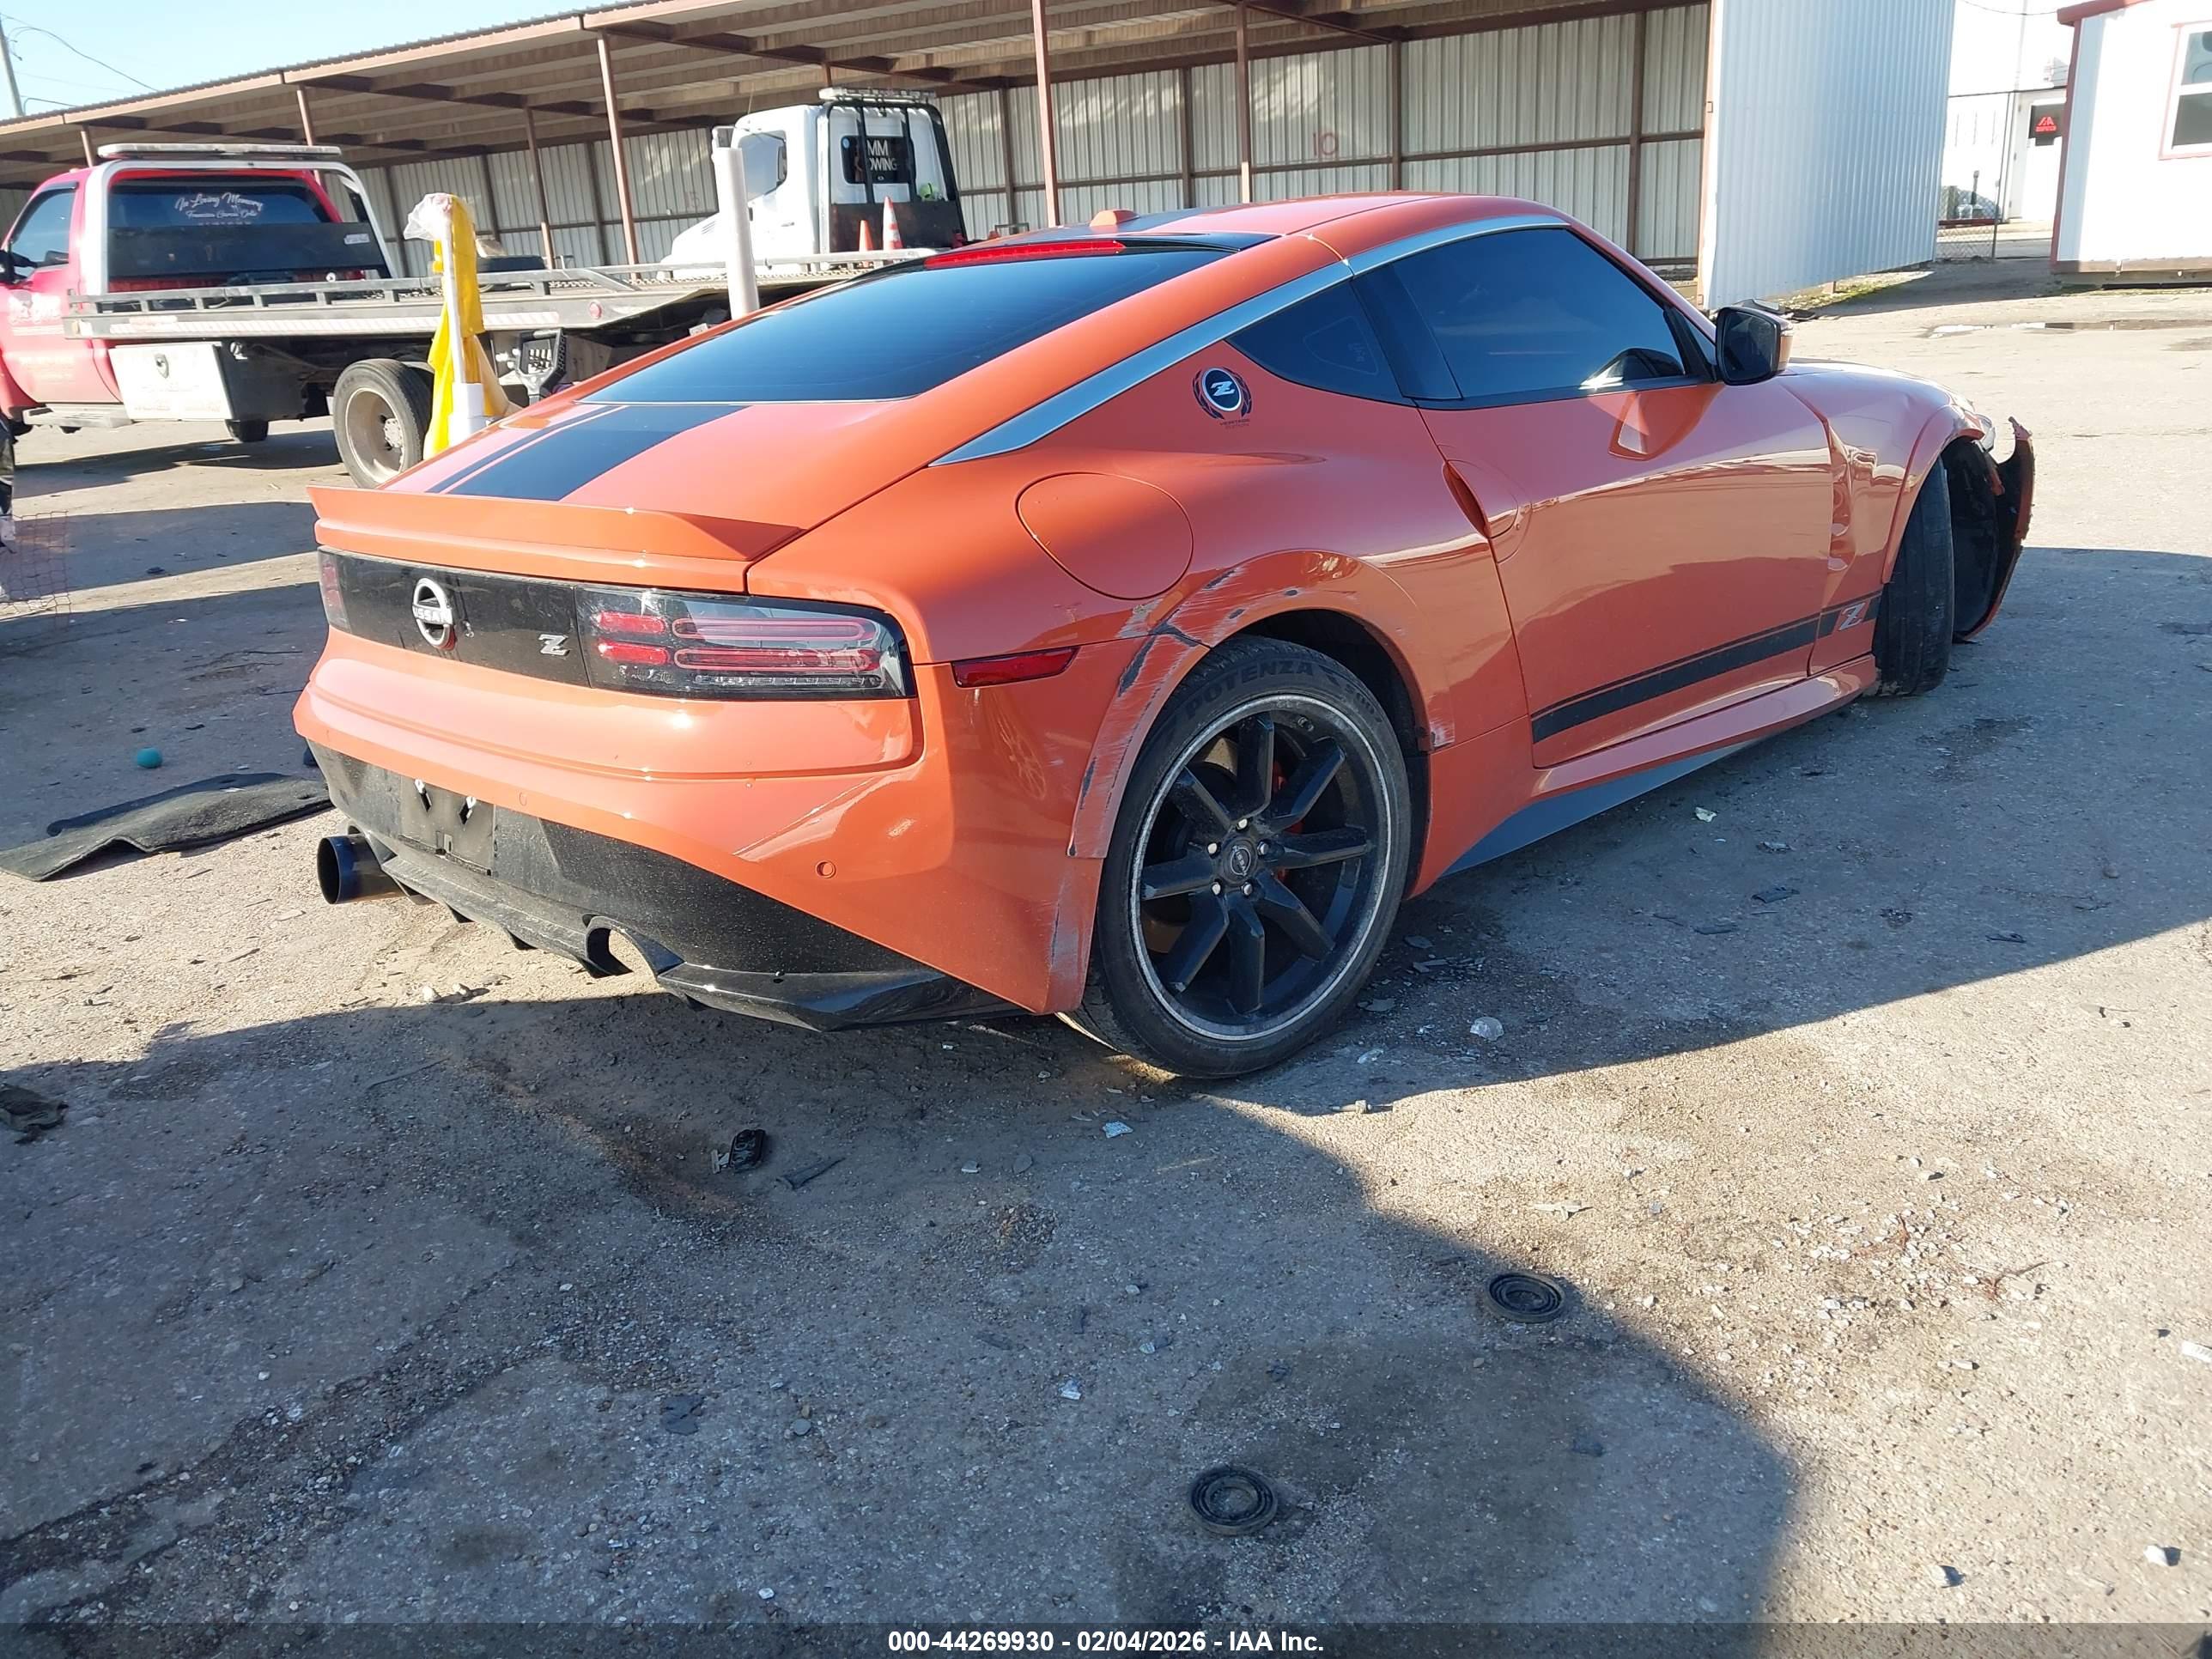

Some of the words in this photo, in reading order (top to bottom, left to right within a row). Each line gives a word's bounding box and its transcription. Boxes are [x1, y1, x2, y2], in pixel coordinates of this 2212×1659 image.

[1312, 131, 1339, 155] 10
[190, 193, 221, 208] Loving
[222, 191, 264, 212] Memory
[1210, 380, 1236, 397] Z
[1838, 602, 1866, 631] Z
[538, 634, 568, 656] Z
[1186, 659, 1315, 720] POTENZA
